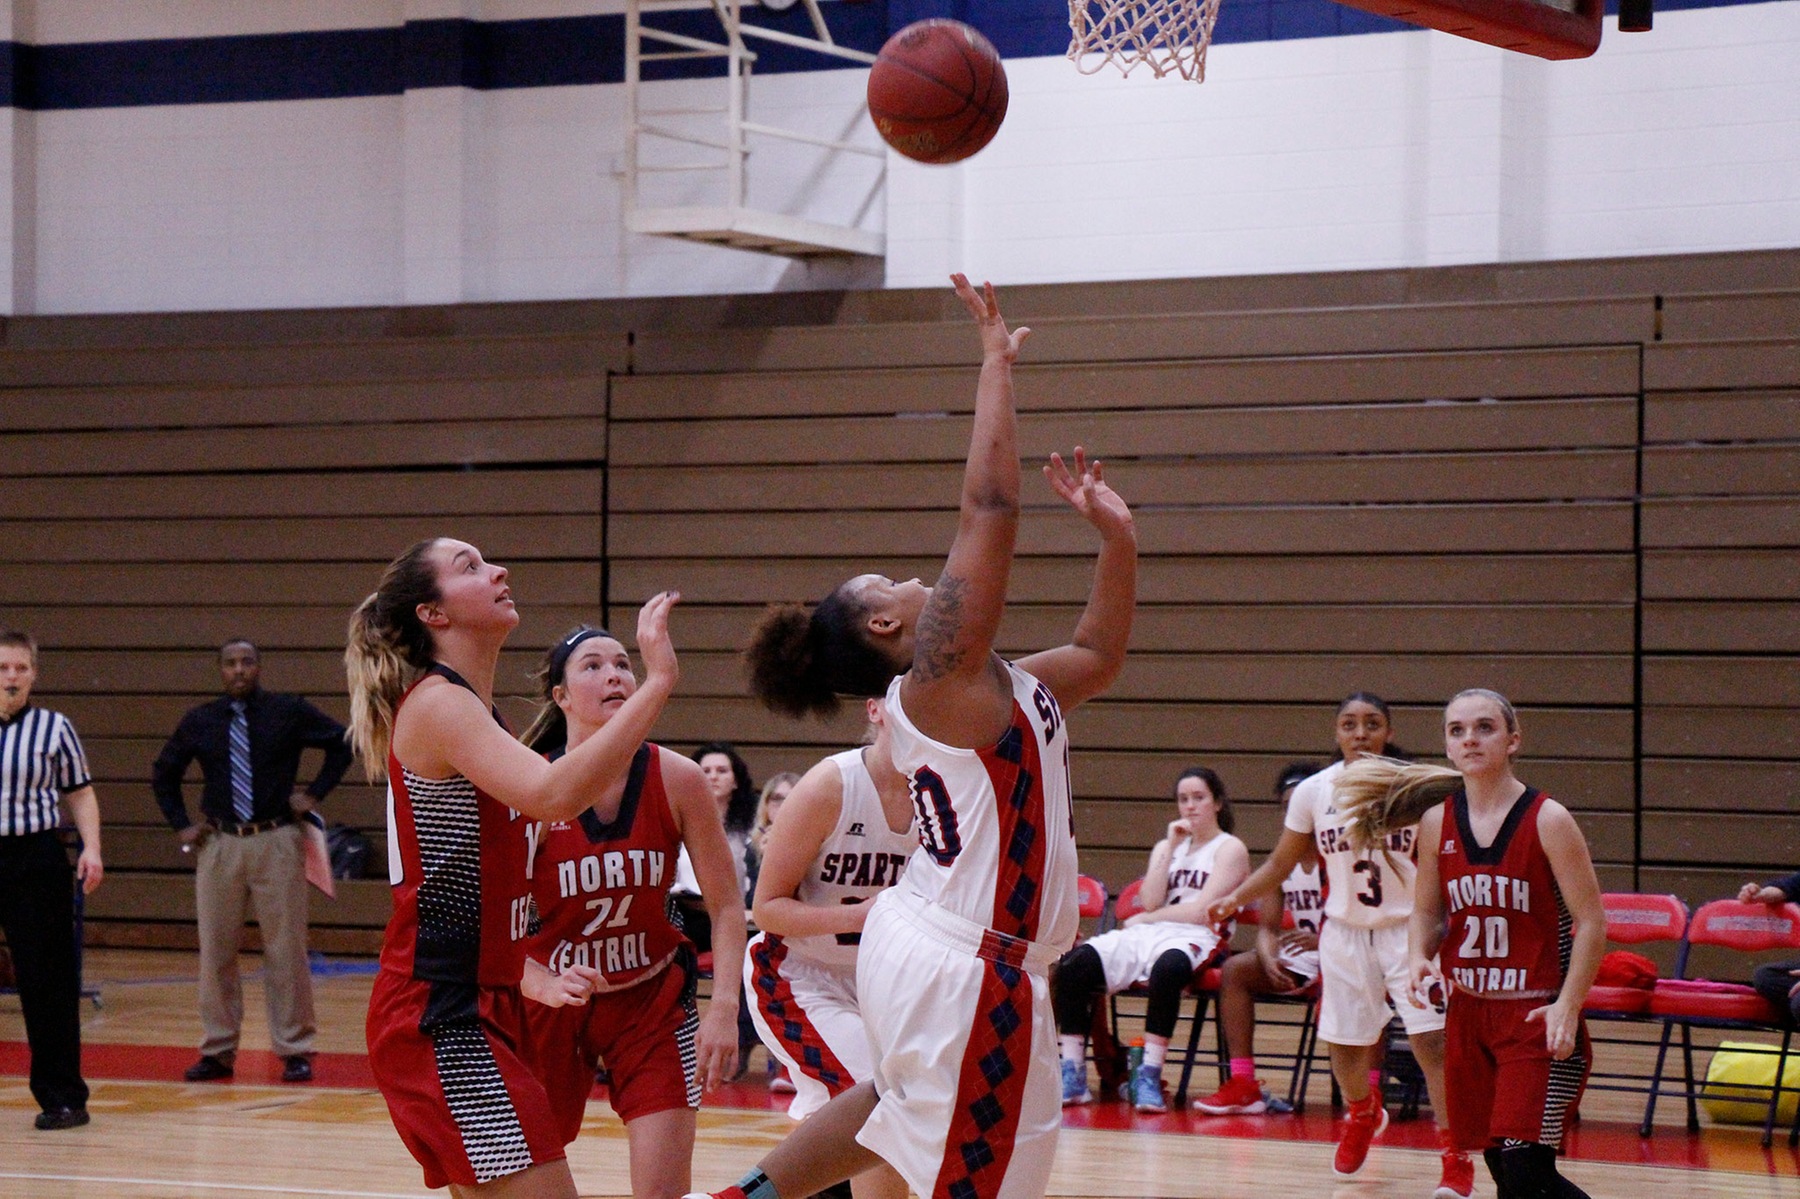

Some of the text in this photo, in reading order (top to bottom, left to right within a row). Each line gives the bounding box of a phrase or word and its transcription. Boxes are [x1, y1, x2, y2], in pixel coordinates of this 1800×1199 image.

[557, 849, 665, 899] NORTH
[820, 852, 911, 887] SPART
[1353, 860, 1383, 908] 3
[1447, 873, 1530, 914] NORTH
[1458, 915, 1509, 959] 20
